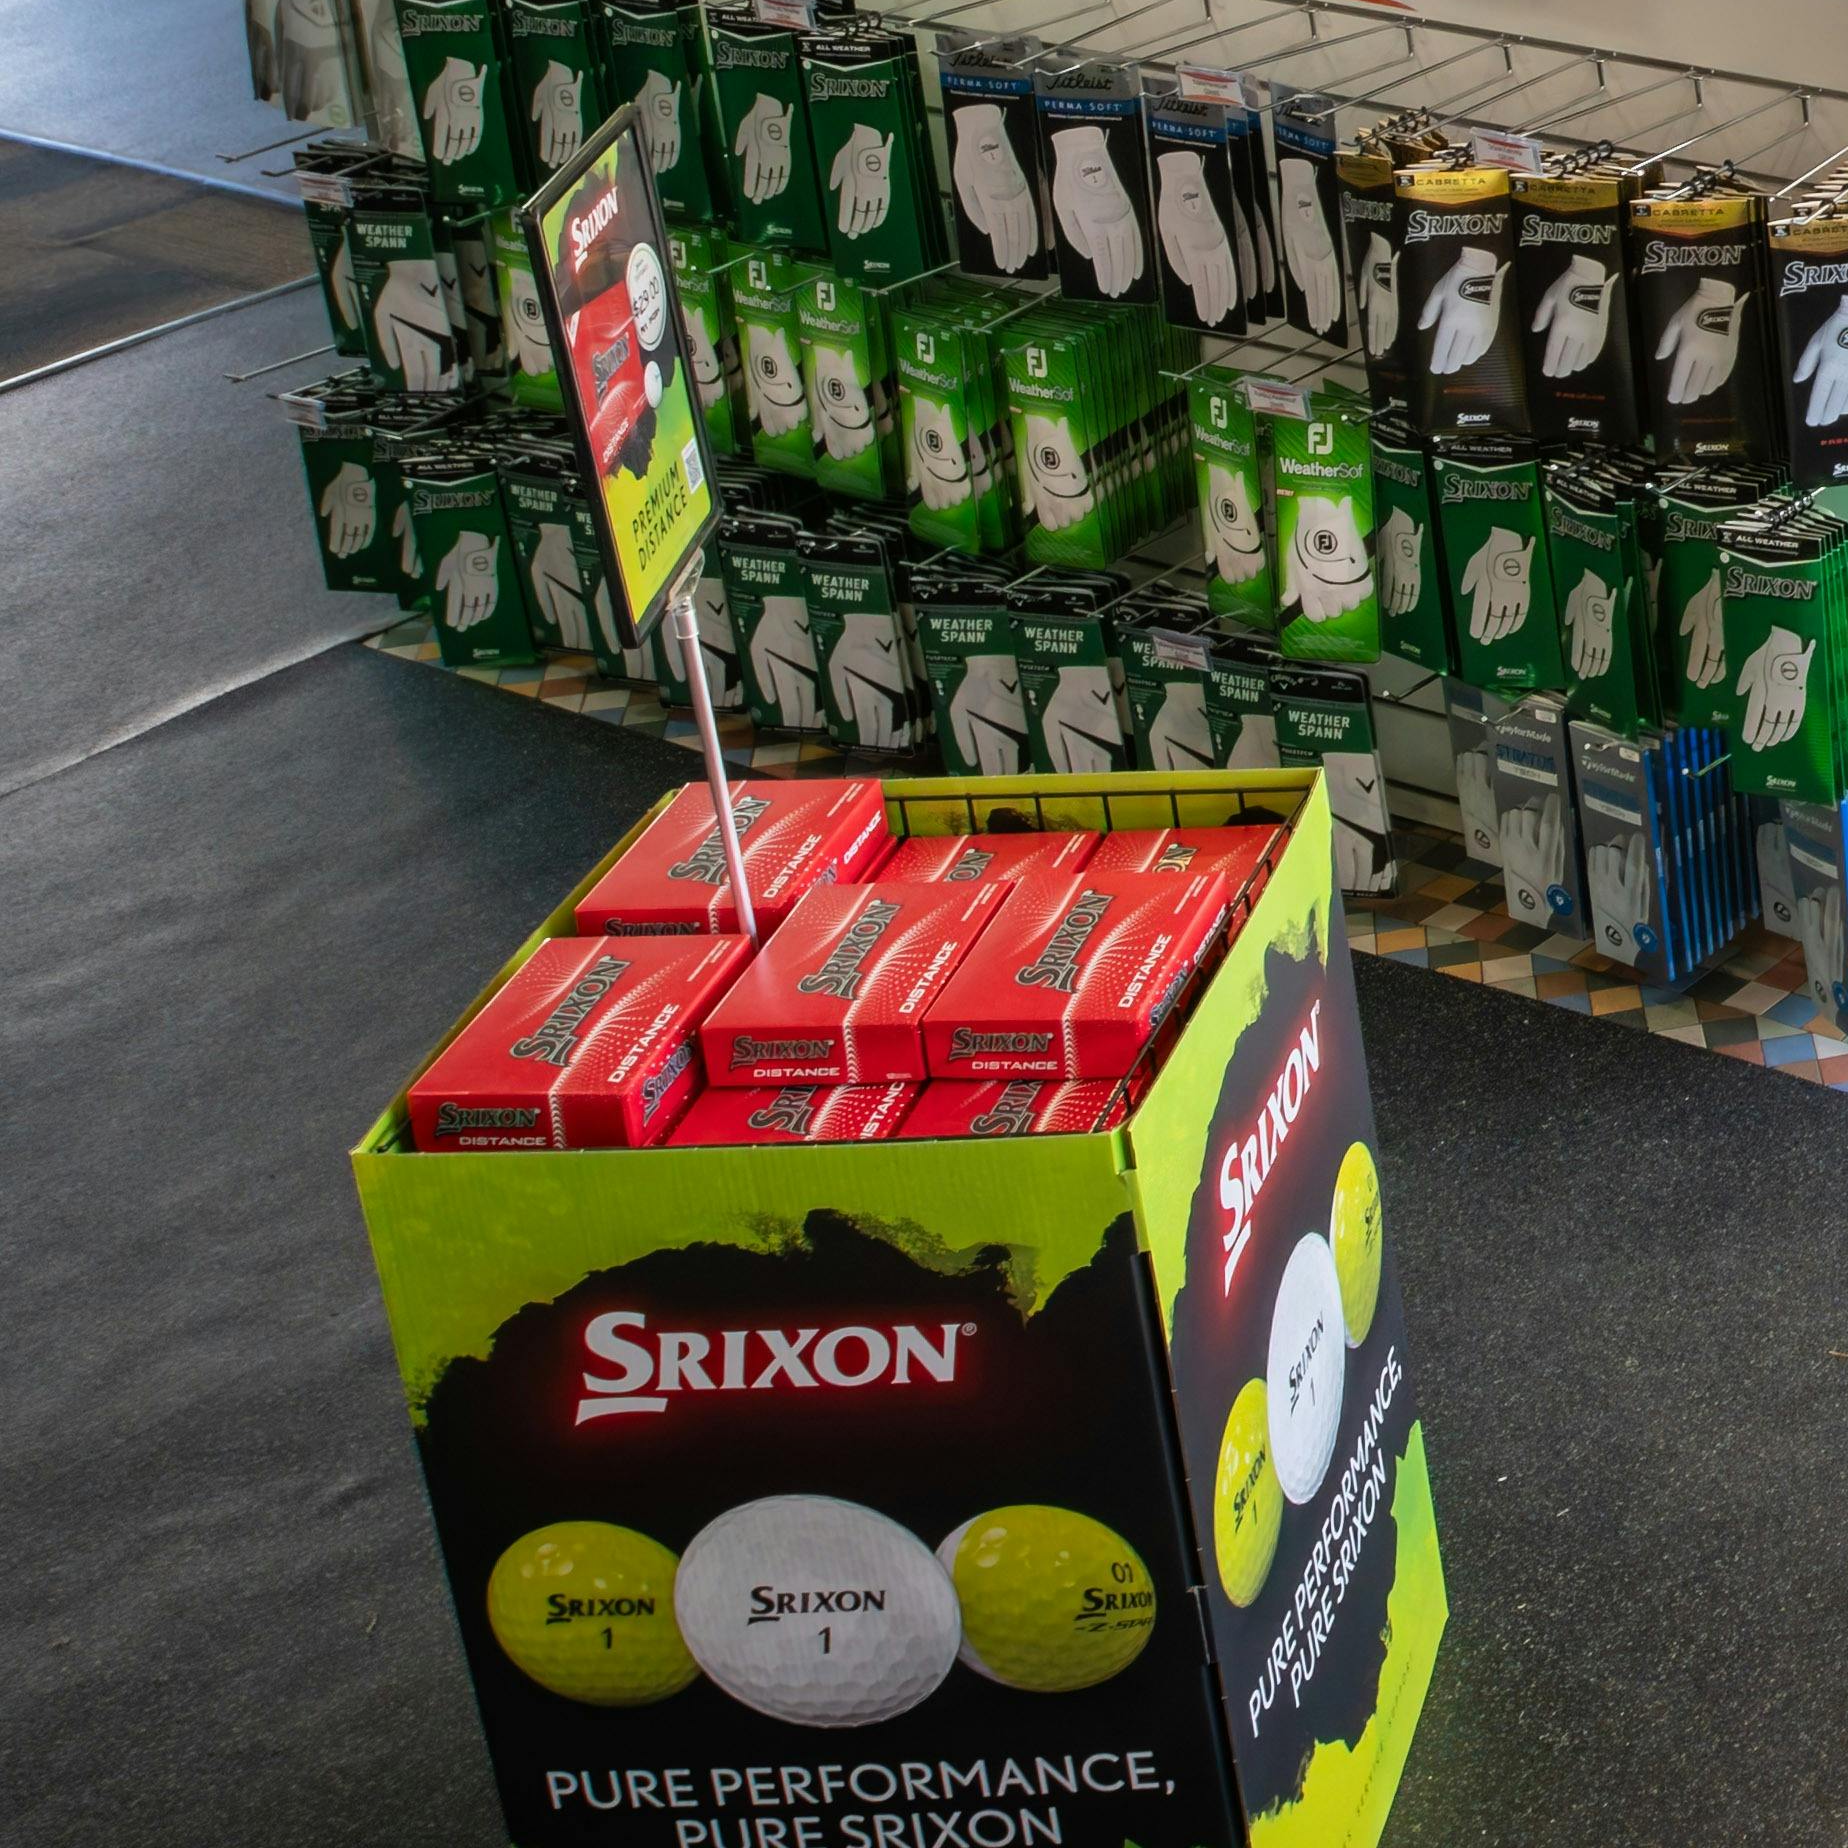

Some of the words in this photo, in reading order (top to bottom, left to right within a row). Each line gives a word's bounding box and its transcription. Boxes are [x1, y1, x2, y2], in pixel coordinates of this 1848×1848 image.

[810, 71, 891, 102] SRIXON
[1047, 73, 1113, 91] Titleist
[1044, 100, 1082, 112] PERMA
[1089, 102, 1121, 113] SOFT
[1416, 176, 1487, 188] CABRETTA
[571, 185, 618, 273] SRIXON
[1405, 210, 1508, 244] SRIXON
[1008, 377, 1076, 403] WeatherSof
[1279, 457, 1364, 481] WeatherSof
[632, 462, 680, 542] PREMIUM
[638, 486, 688, 572] DISTANCE
[1724, 563, 1818, 602] SRIXON
[1287, 708, 1351, 730] WEATHER
[1297, 721, 1343, 740] SPANN
[798, 898, 903, 1000] SRIXON
[898, 940, 958, 1015] DISTANCE
[510, 954, 633, 1067] SRIXON
[730, 1035, 835, 1066] SRIXON
[752, 1066, 841, 1079] DISTANCE
[435, 1101, 541, 1135] SRIXON
[458, 1135, 548, 1149] DISTANCE
[1217, 998, 1322, 1297] SRIXON
[574, 1310, 962, 1428] SRIXON
[1247, 1610, 1296, 1738] PURE
[1296, 1345, 1403, 1630] PERFORMANCE,
[1290, 1596, 1336, 1709] PURE
[1332, 1448, 1387, 1606] SRIXON
[546, 1592, 655, 1625] SRIXON
[747, 1584, 885, 1627] SRIXON
[817, 1629, 832, 1656] 1
[548, 1769, 700, 1811] PURE
[713, 1752, 1175, 1807] PERFORMANCE,
[676, 1817, 829, 1848] PURE
[841, 1808, 1060, 1848] SRIXON
